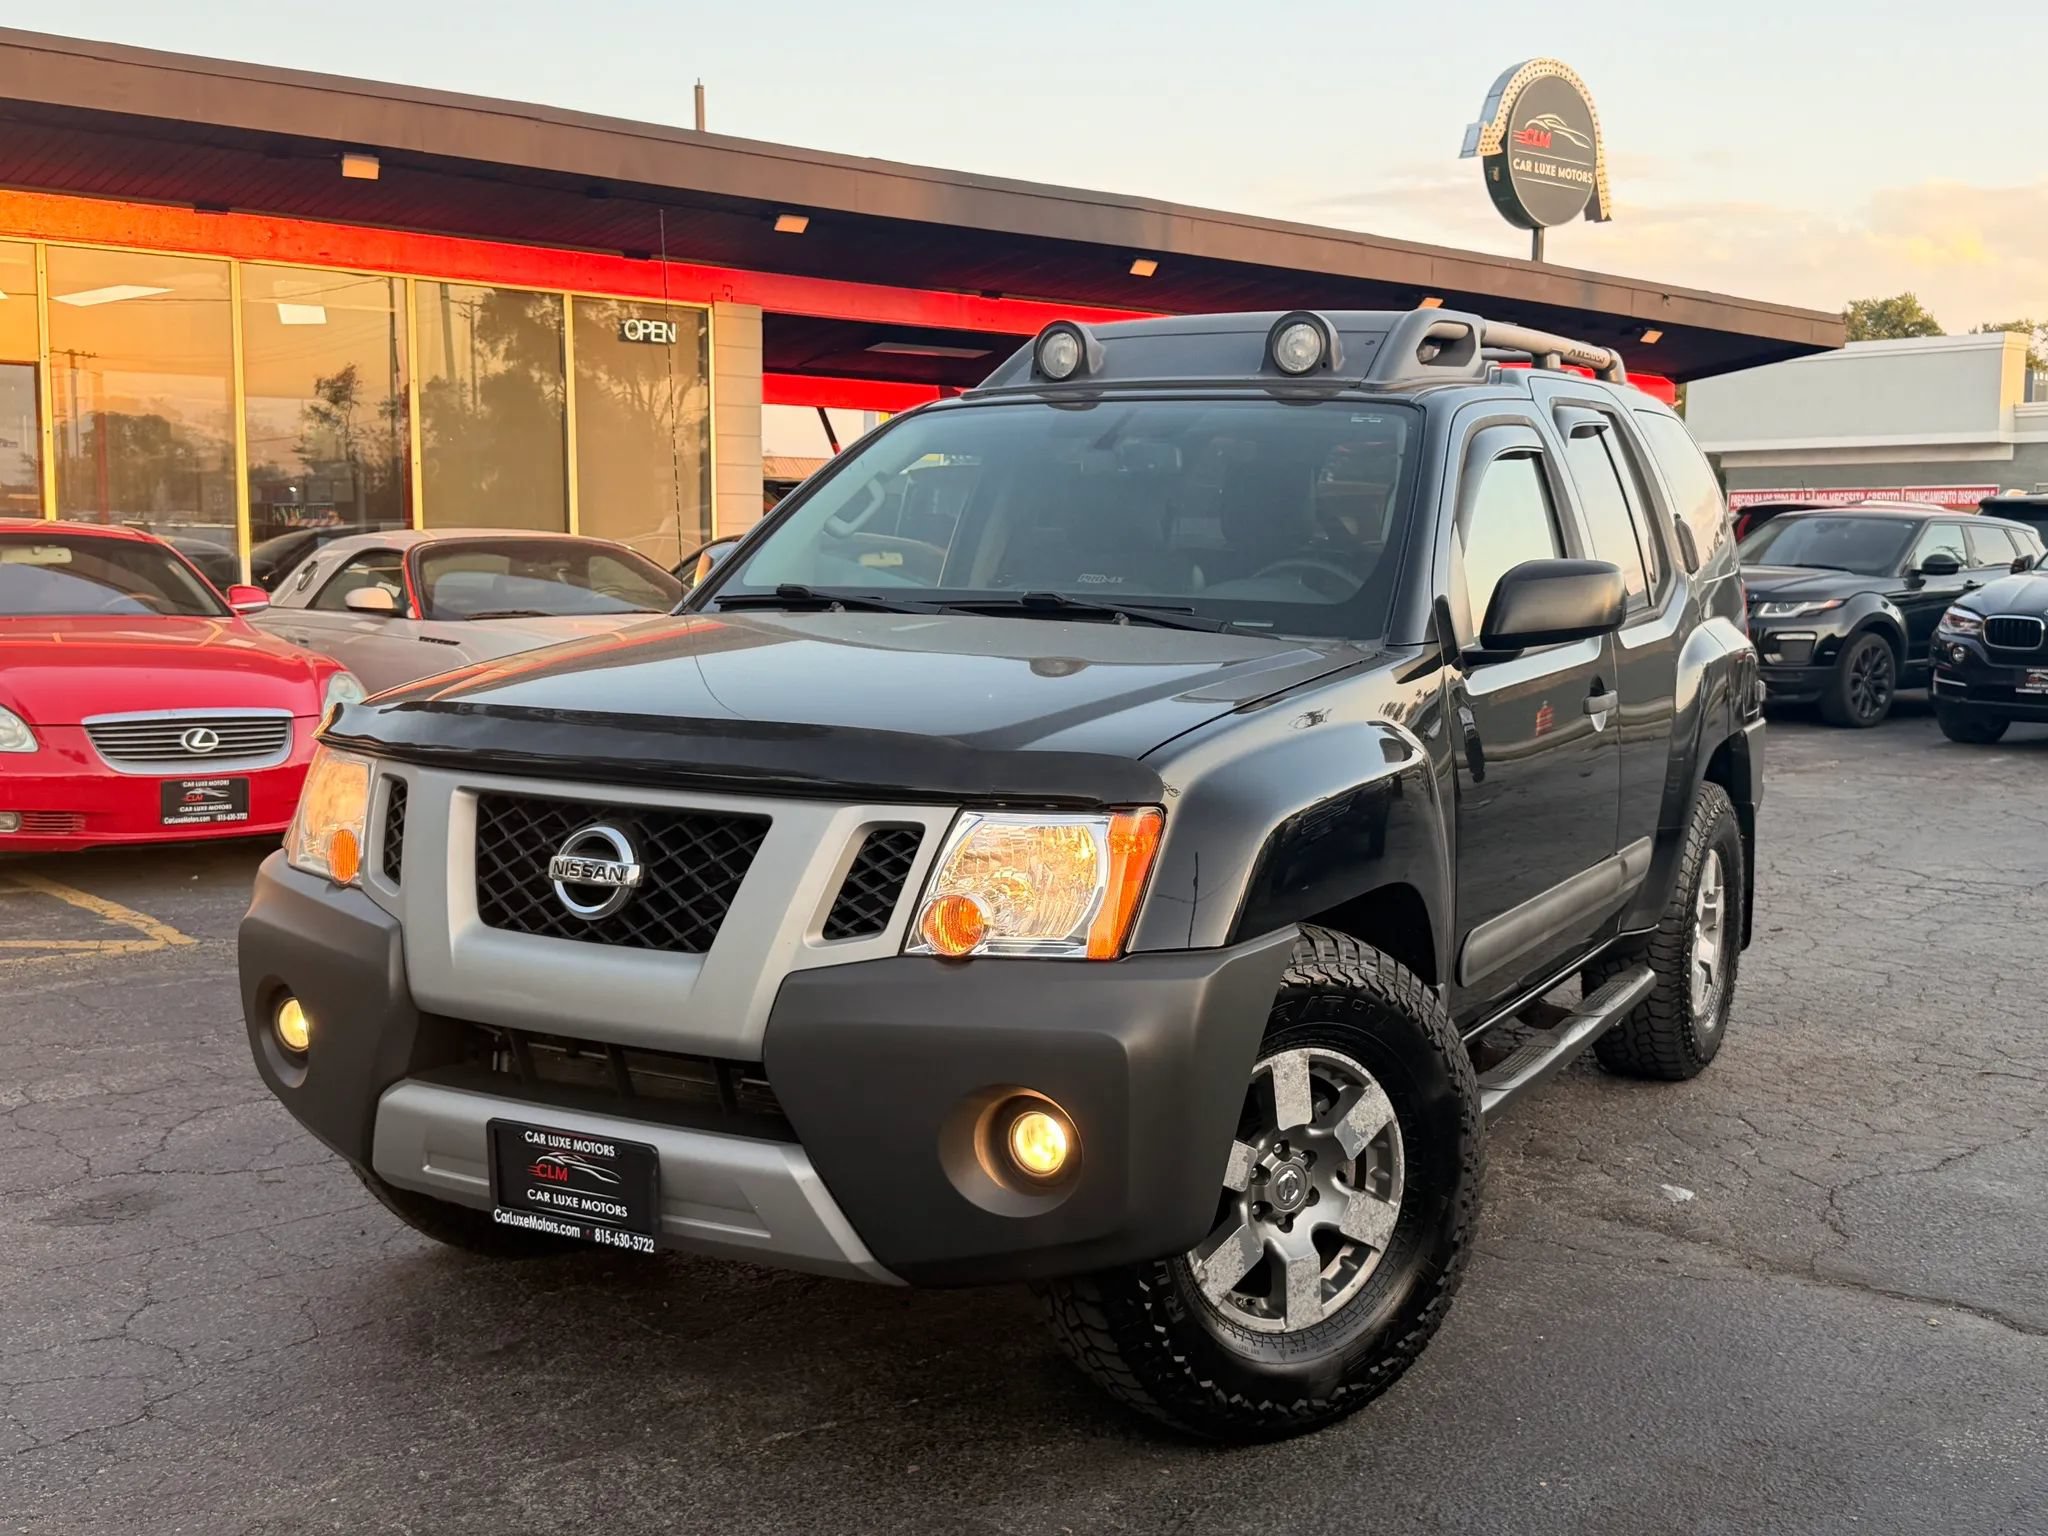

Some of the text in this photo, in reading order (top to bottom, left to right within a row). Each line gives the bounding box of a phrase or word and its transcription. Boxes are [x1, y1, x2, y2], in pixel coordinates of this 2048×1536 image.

[1527, 128, 1552, 148] CLM
[1513, 158, 1593, 184] CAR LUXE MOTORS
[624, 319, 676, 343] OPEN
[553, 860, 624, 882] NISSAN
[524, 1131, 615, 1157] CAR LUXE MOTORS
[536, 1163, 569, 1182] CLM
[527, 1188, 628, 1218] CAR LUXE MOTORS
[494, 1208, 655, 1253] CarLuxeMotors.com 815-630-3722
